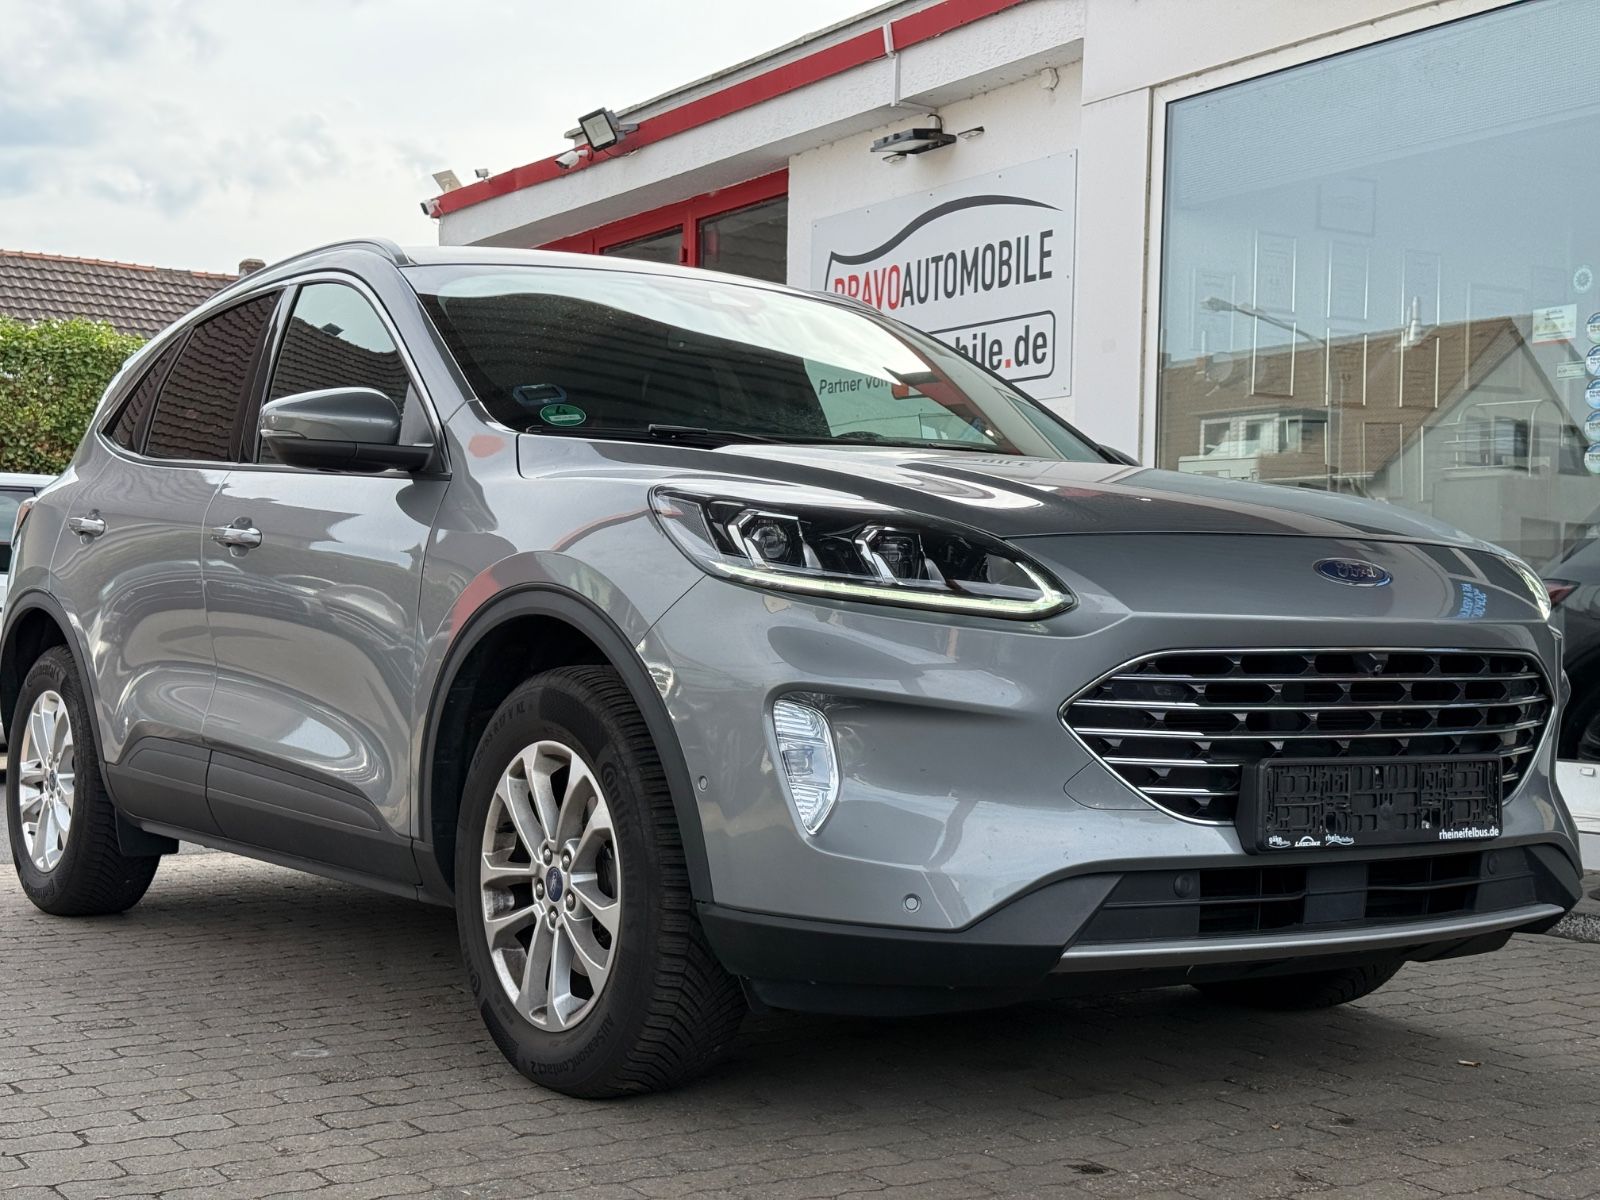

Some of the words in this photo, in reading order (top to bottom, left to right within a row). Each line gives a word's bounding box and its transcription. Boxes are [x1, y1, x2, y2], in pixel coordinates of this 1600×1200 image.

[955, 324, 1048, 371] ile.de
[819, 379, 862, 395] Partner
[1335, 562, 1377, 578] Ford
[1438, 825, 1499, 840] rheineifelbus.de
